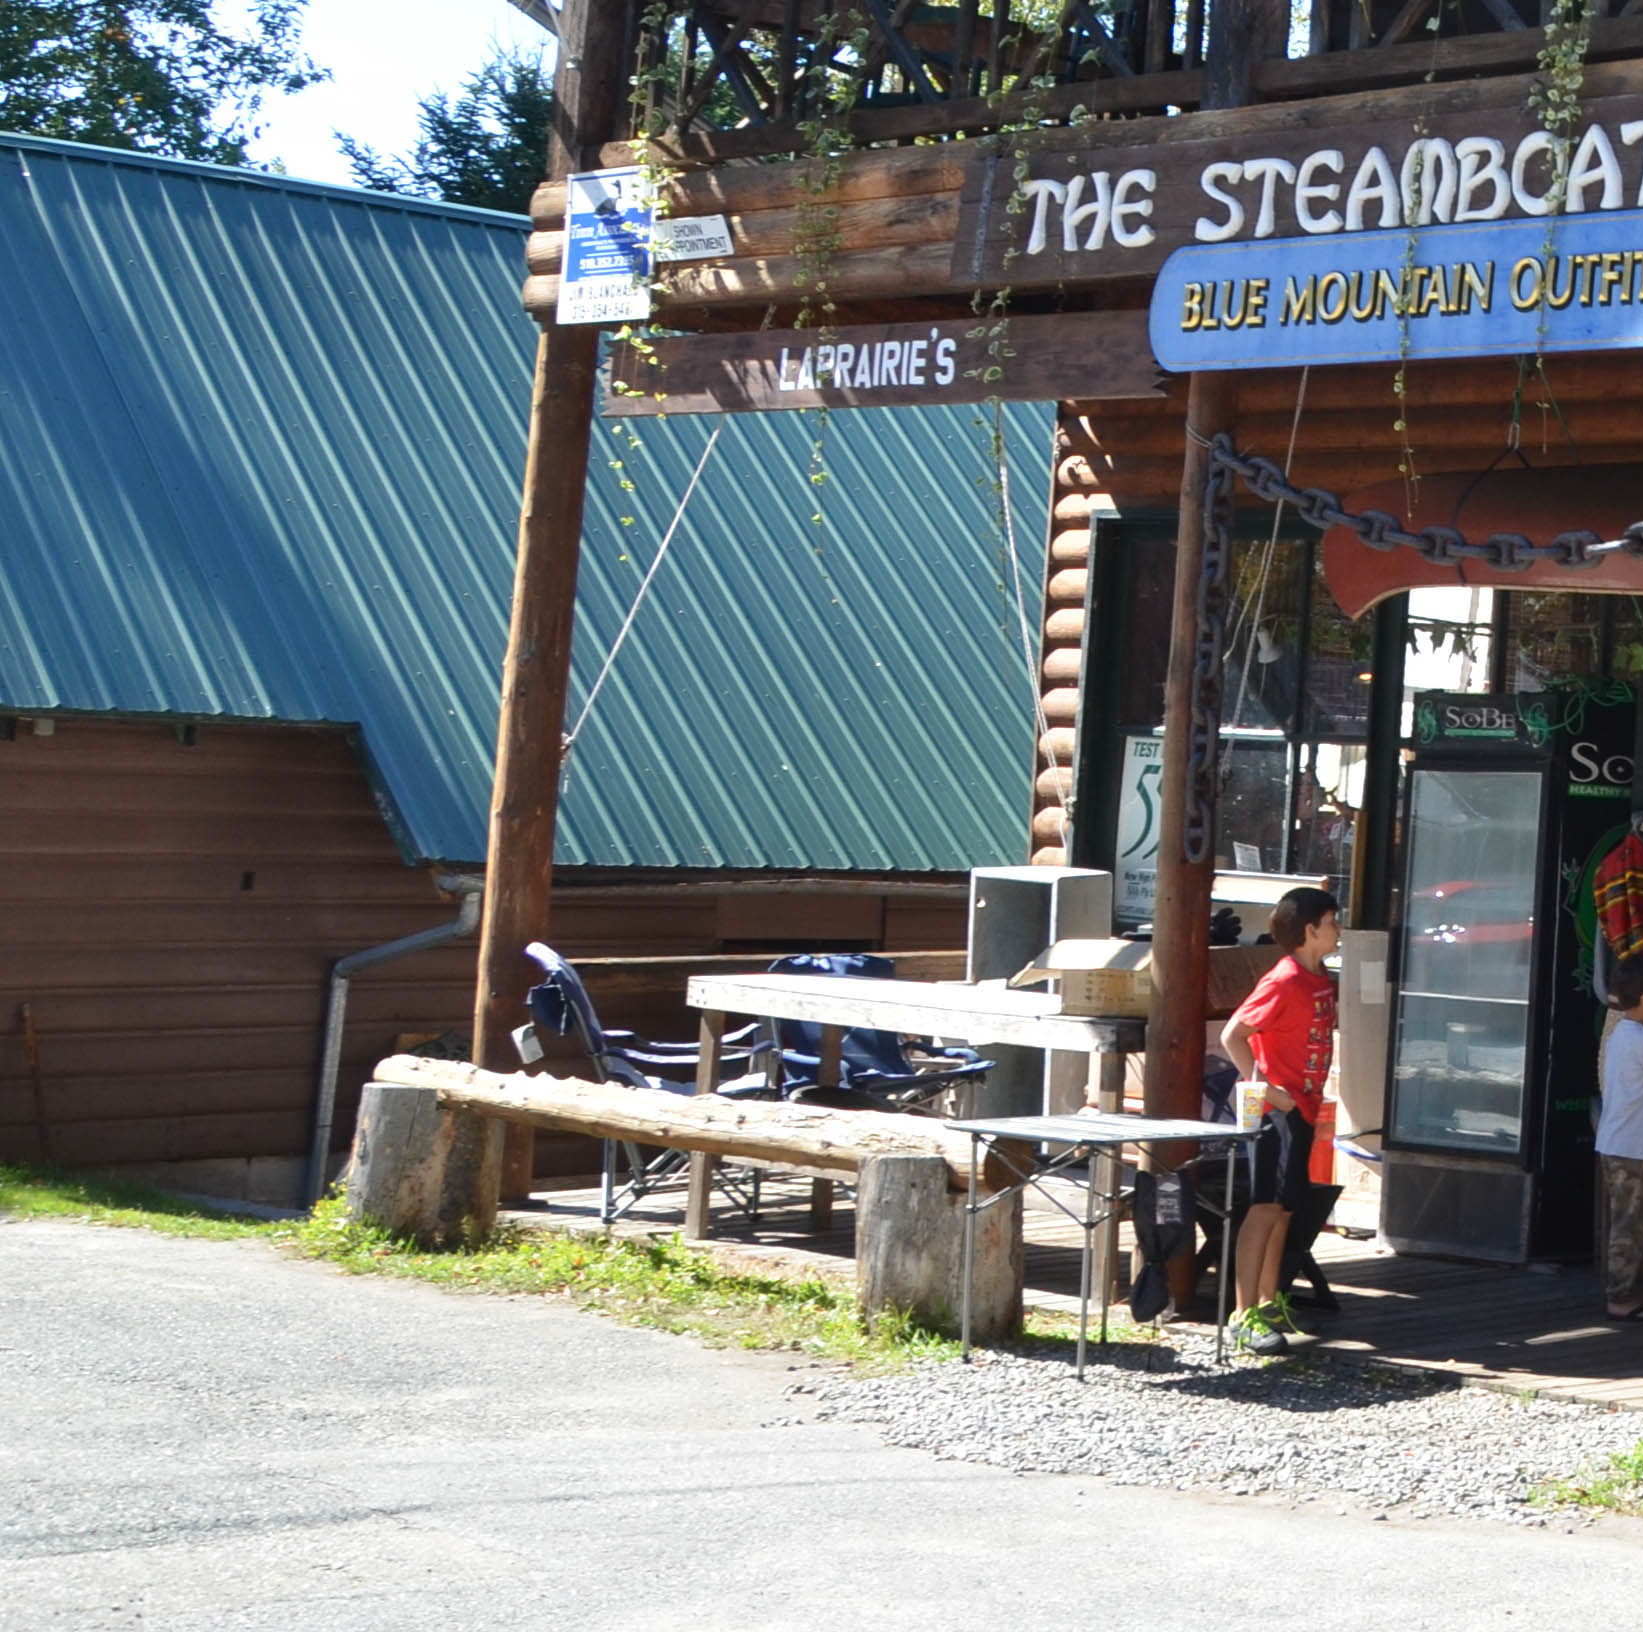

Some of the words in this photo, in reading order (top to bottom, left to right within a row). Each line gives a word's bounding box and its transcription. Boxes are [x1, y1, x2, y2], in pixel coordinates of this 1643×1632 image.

[1020, 167, 1157, 256] THE
[1180, 275, 1270, 332] BLUE
[1280, 260, 1495, 326] MOUNTAIN
[778, 326, 957, 392] LAPRAIRIE'S
[1134, 741, 1160, 758] TEST
